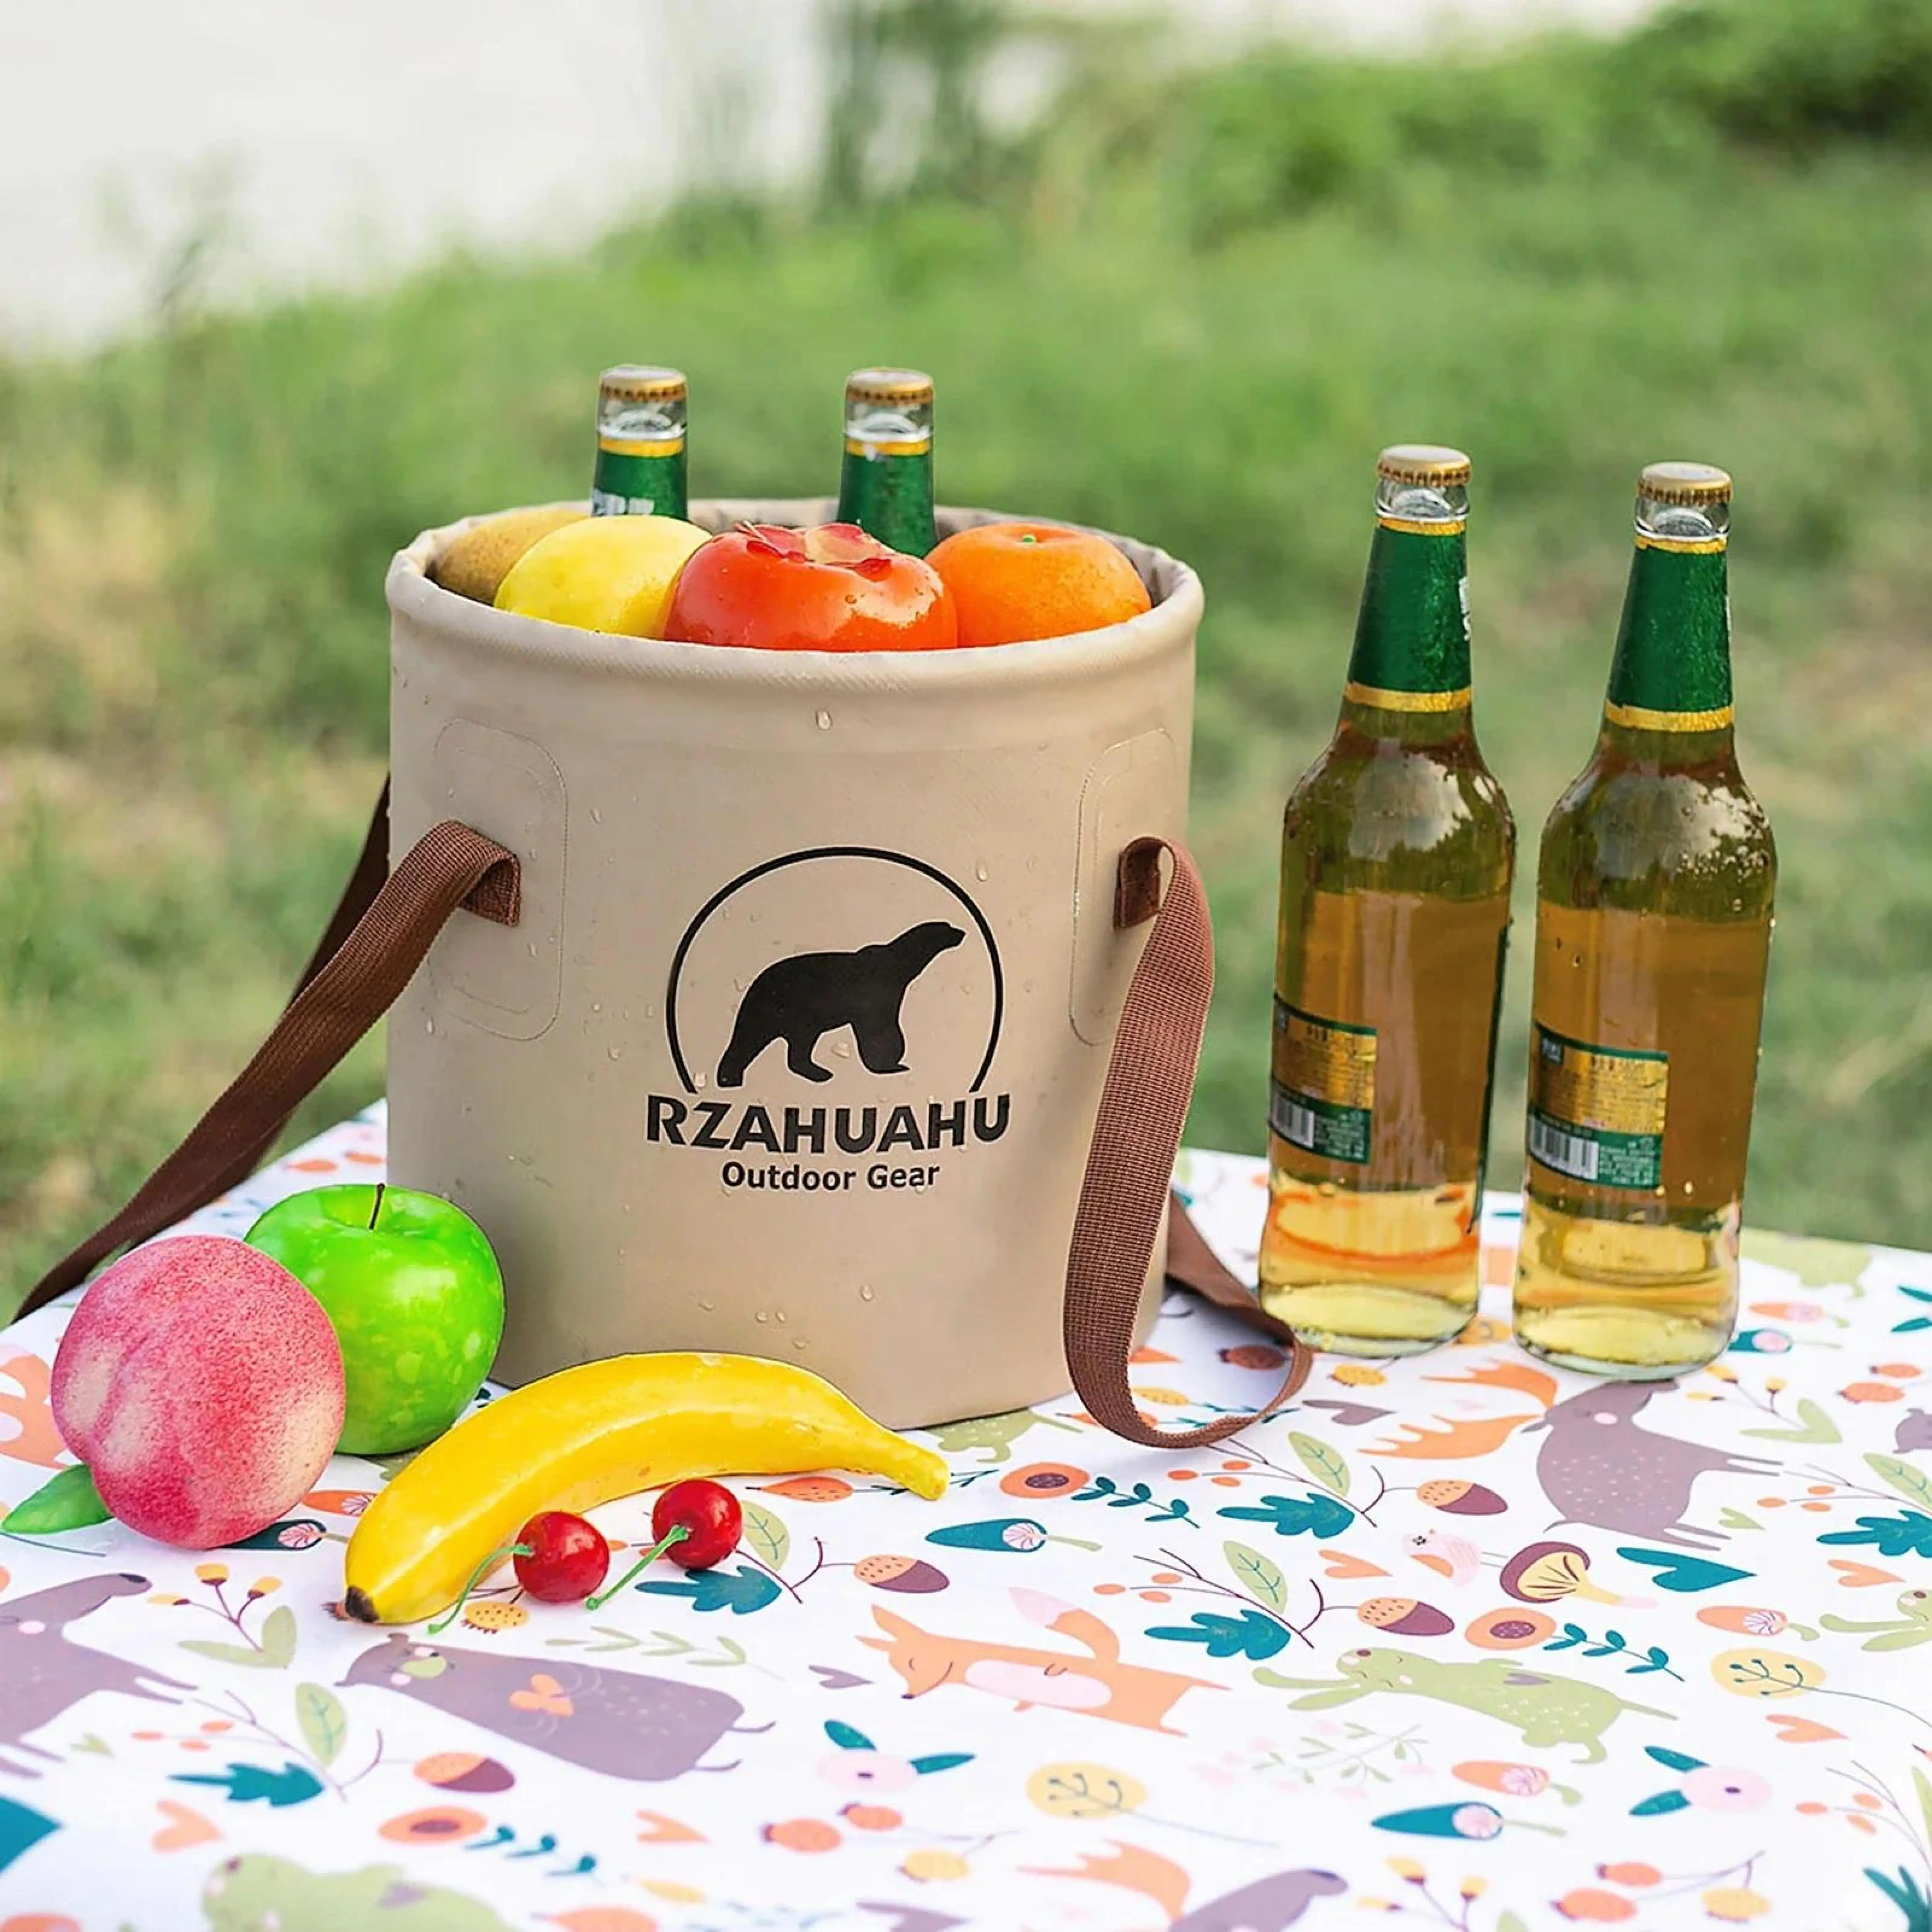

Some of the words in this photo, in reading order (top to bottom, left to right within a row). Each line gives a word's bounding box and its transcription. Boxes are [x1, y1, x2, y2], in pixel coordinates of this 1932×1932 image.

[646, 1094, 1010, 1154] RZAHUAHU
[722, 1161, 856, 1190] Outdoor
[867, 1164, 940, 1189] Gear
